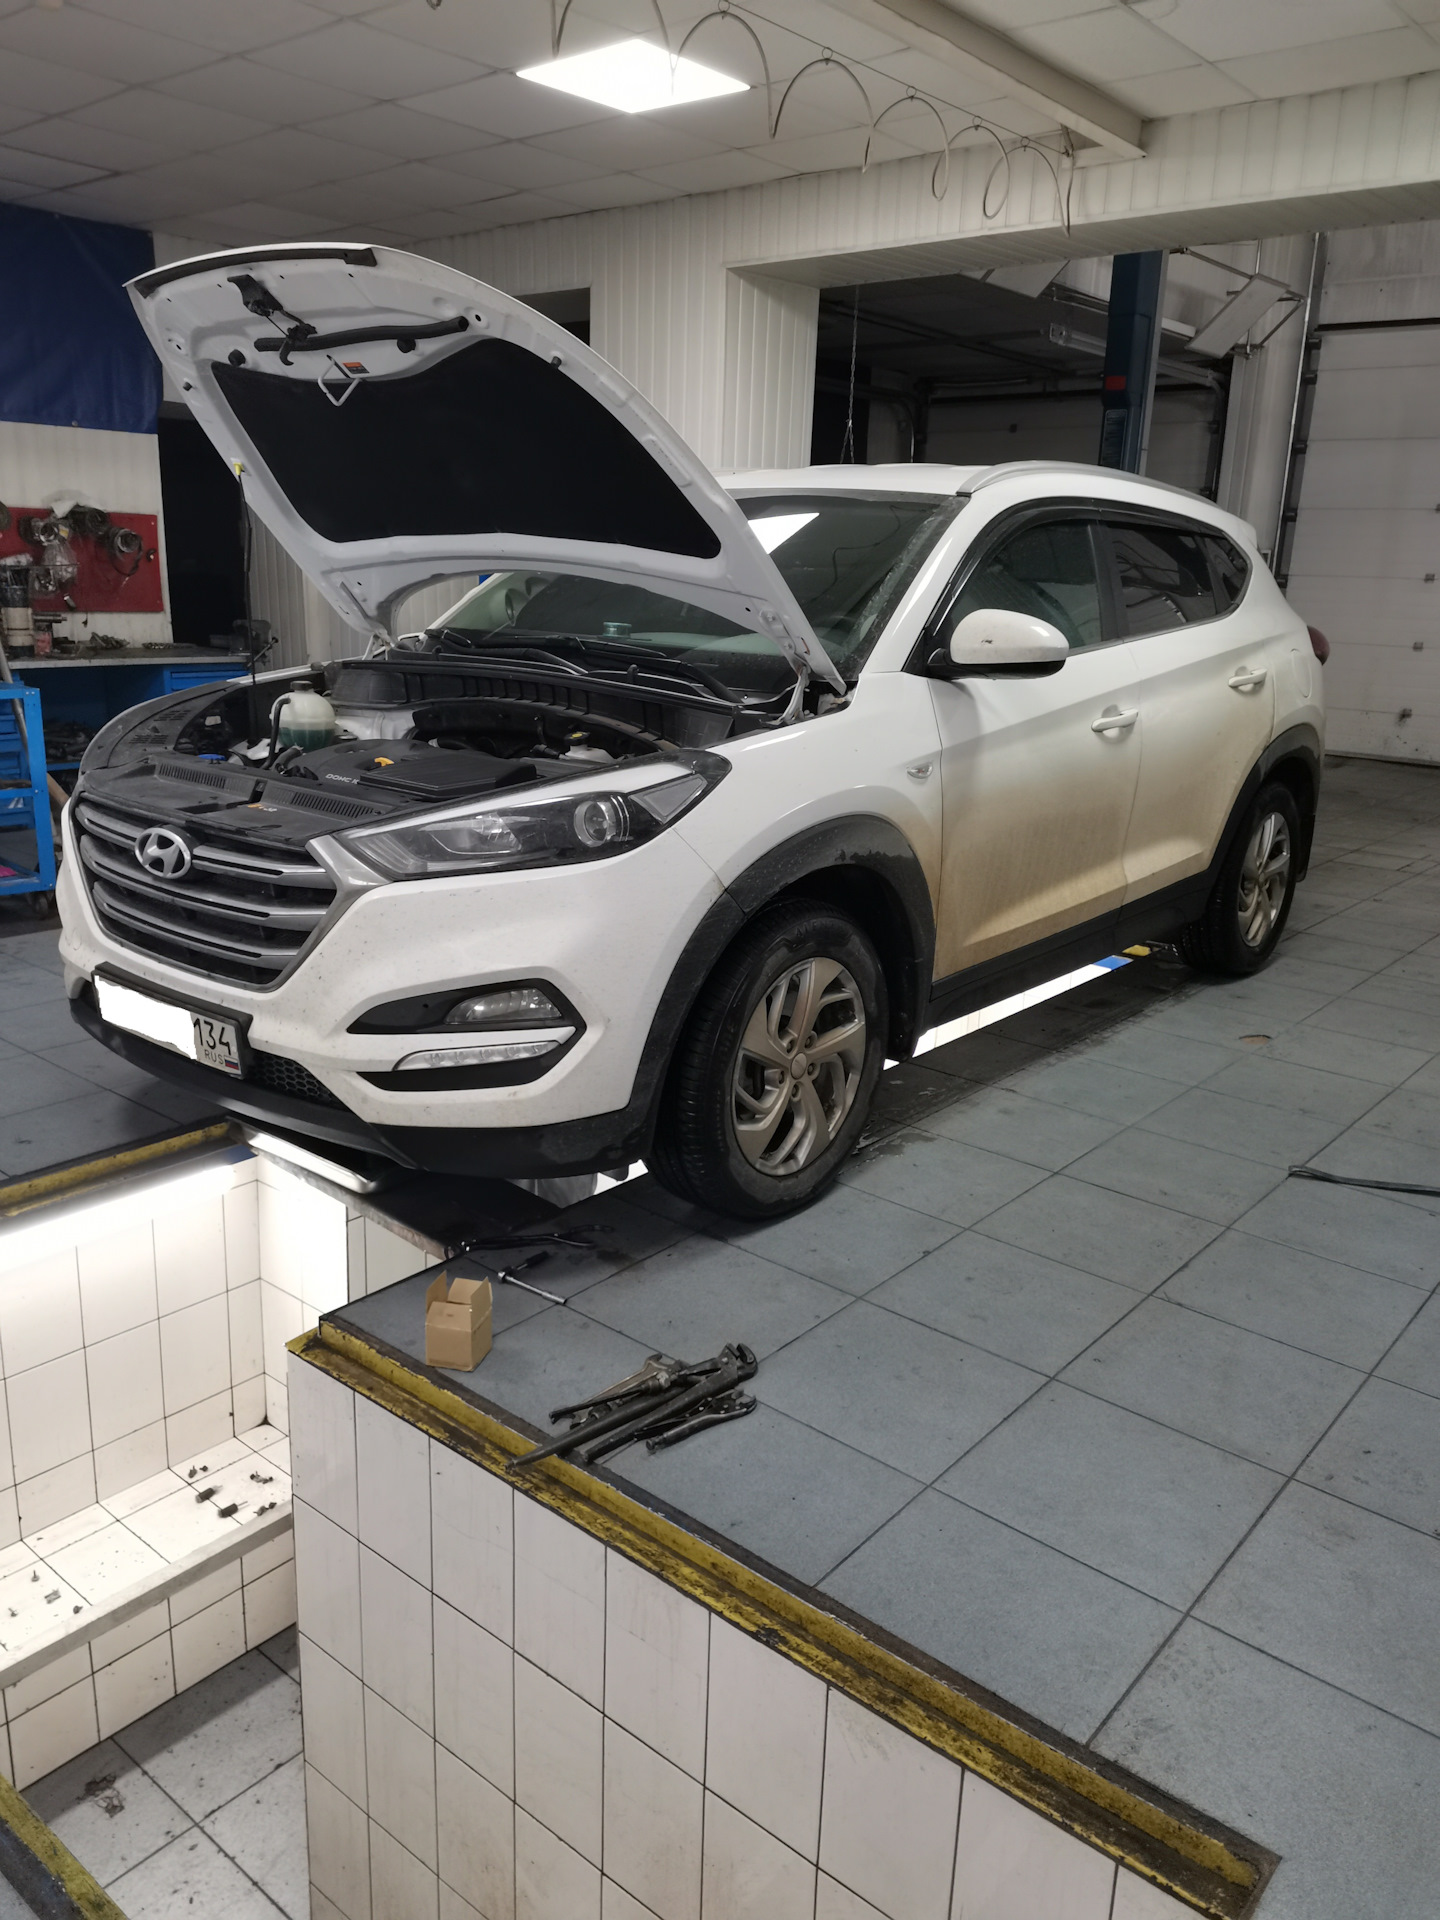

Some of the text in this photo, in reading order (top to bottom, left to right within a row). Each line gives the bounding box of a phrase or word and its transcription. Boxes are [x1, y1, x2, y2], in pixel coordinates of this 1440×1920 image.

[325, 773, 352, 783] DOHC
[194, 1018, 231, 1056] 134
[204, 1049, 224, 1065] RUS
